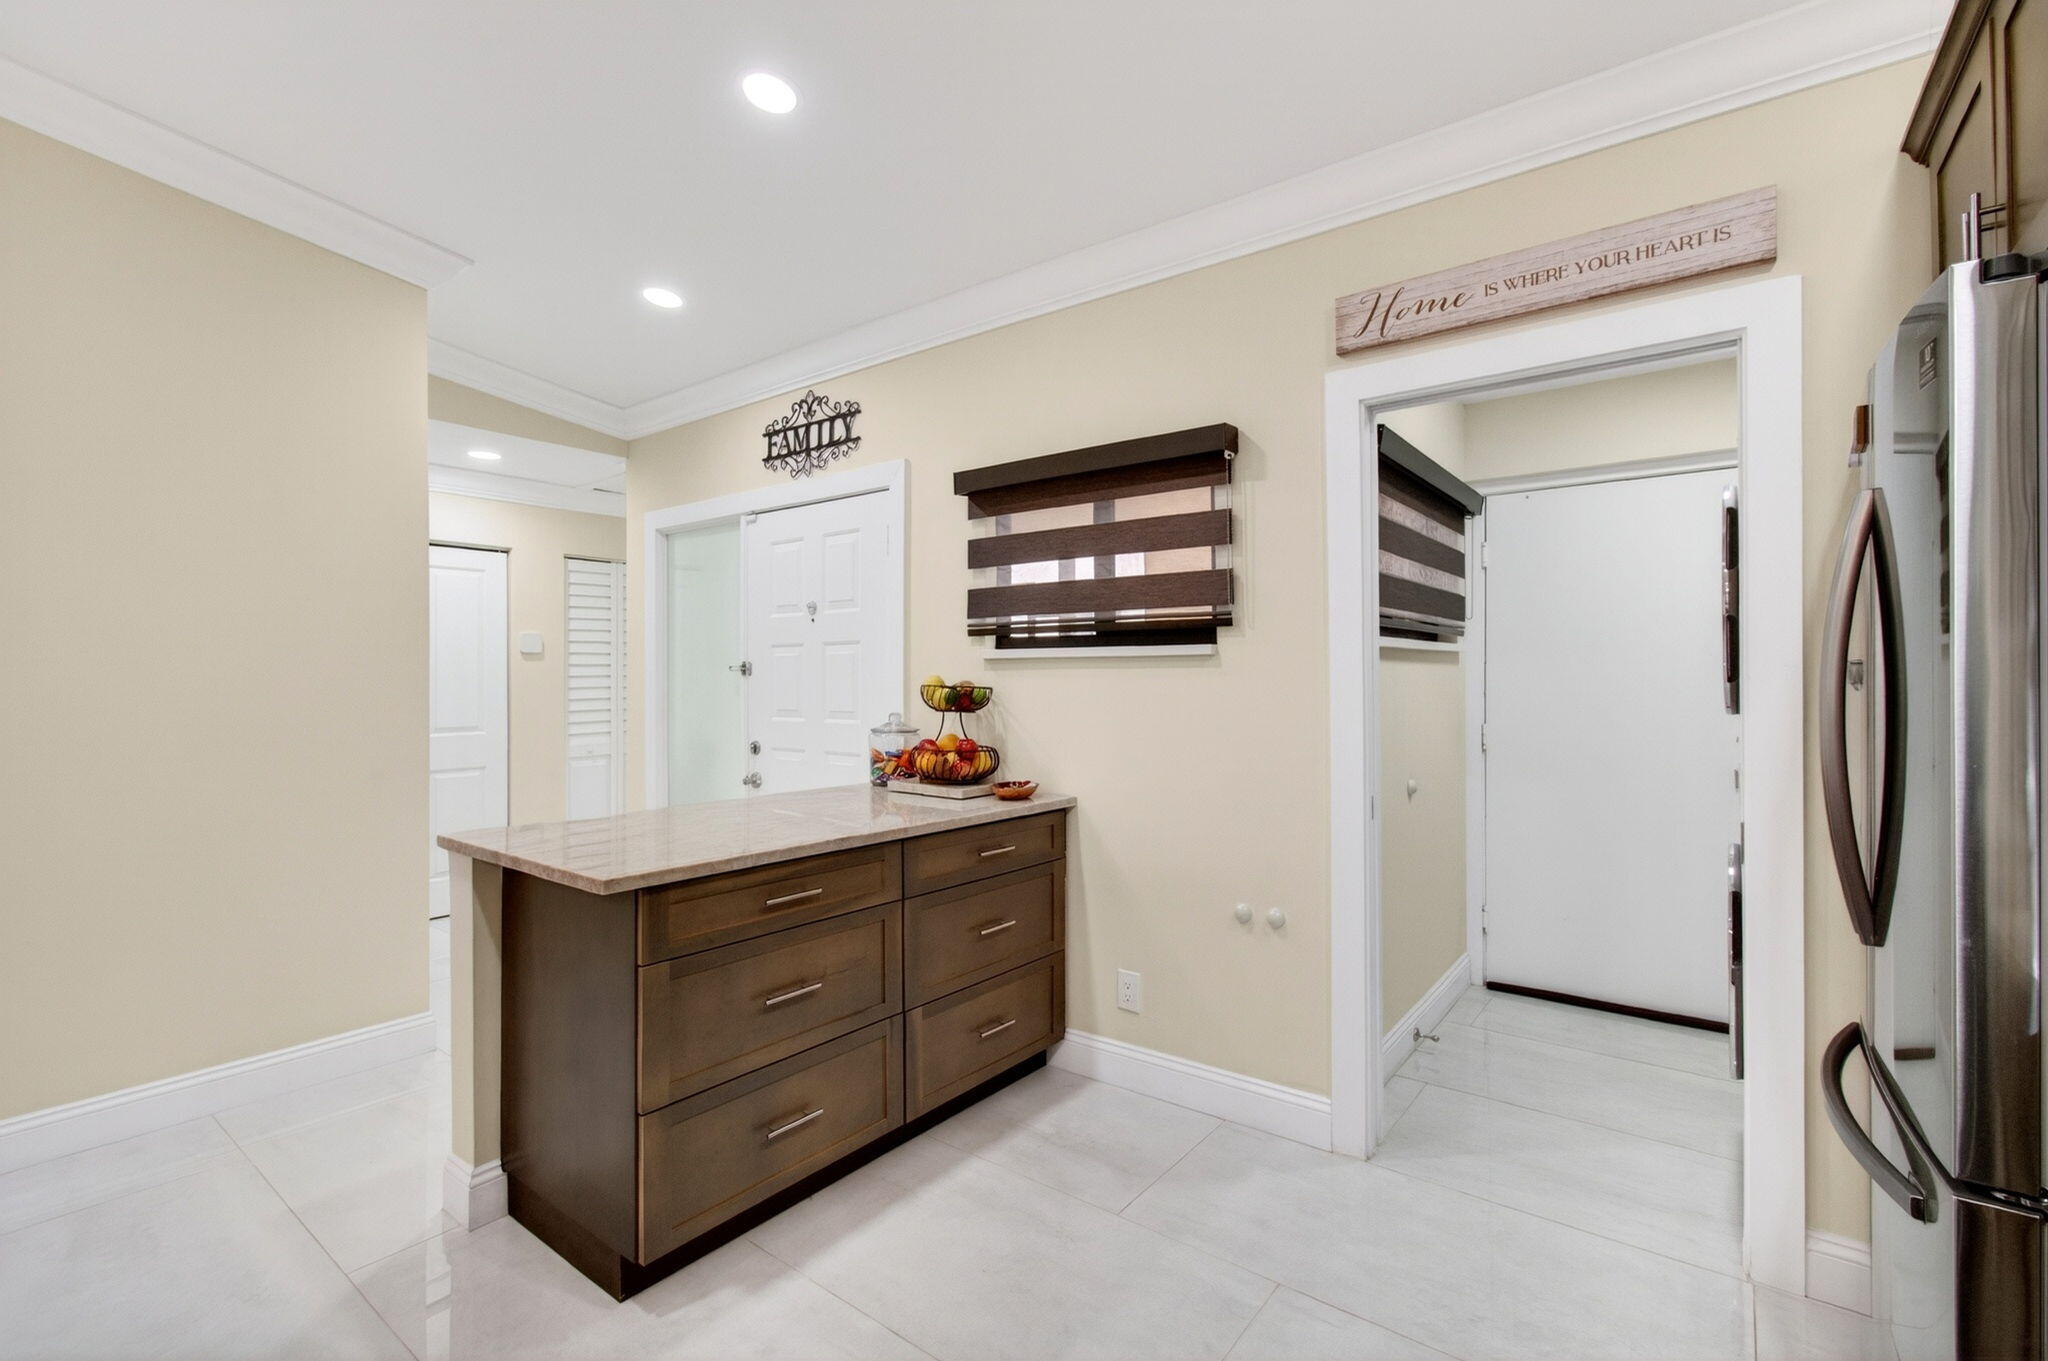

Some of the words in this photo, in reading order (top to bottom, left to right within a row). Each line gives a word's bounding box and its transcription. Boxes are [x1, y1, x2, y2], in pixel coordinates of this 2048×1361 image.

[1353, 287, 1474, 338] Home
[1484, 282, 1498, 297] IS
[1503, 264, 1569, 291] WHERE
[1575, 250, 1631, 275] YOUR
[1636, 230, 1708, 261] HEART
[1713, 225, 1731, 243] IS
[763, 409, 860, 462] FAMILY
